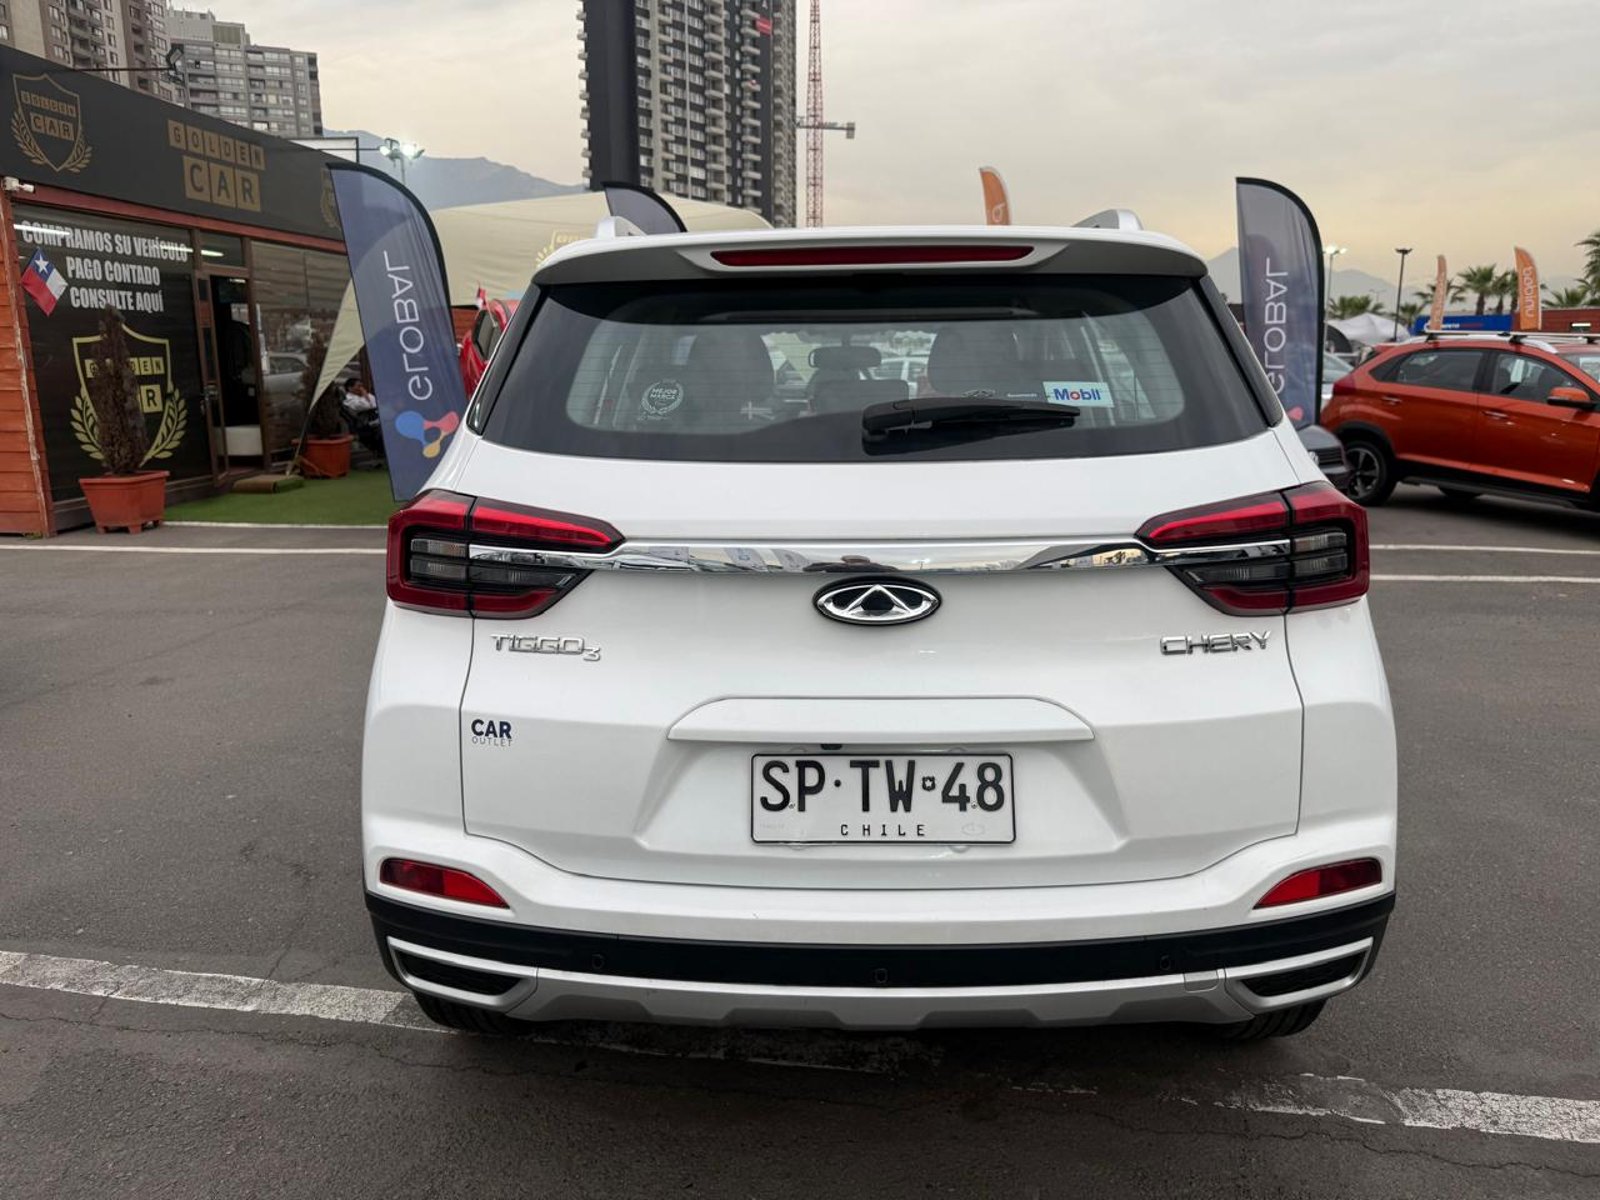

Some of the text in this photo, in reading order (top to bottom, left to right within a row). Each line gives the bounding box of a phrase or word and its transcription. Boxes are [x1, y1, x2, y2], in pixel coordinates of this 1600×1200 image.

[32, 113, 74, 139] CAR
[171, 124, 263, 168] GOLDEN
[188, 162, 256, 206] CAR
[22, 220, 188, 262] COMPRAMOS SU VEHÍCULO
[66, 256, 160, 286] PAGO CONTADO
[70, 287, 164, 313] CONSULTE AQUÍ
[1053, 388, 1102, 401] Mobil
[1160, 631, 1271, 655] CHERY
[471, 719, 511, 739] CAR
[471, 736, 512, 747] OUTLET
[840, 824, 925, 837] CHILE
